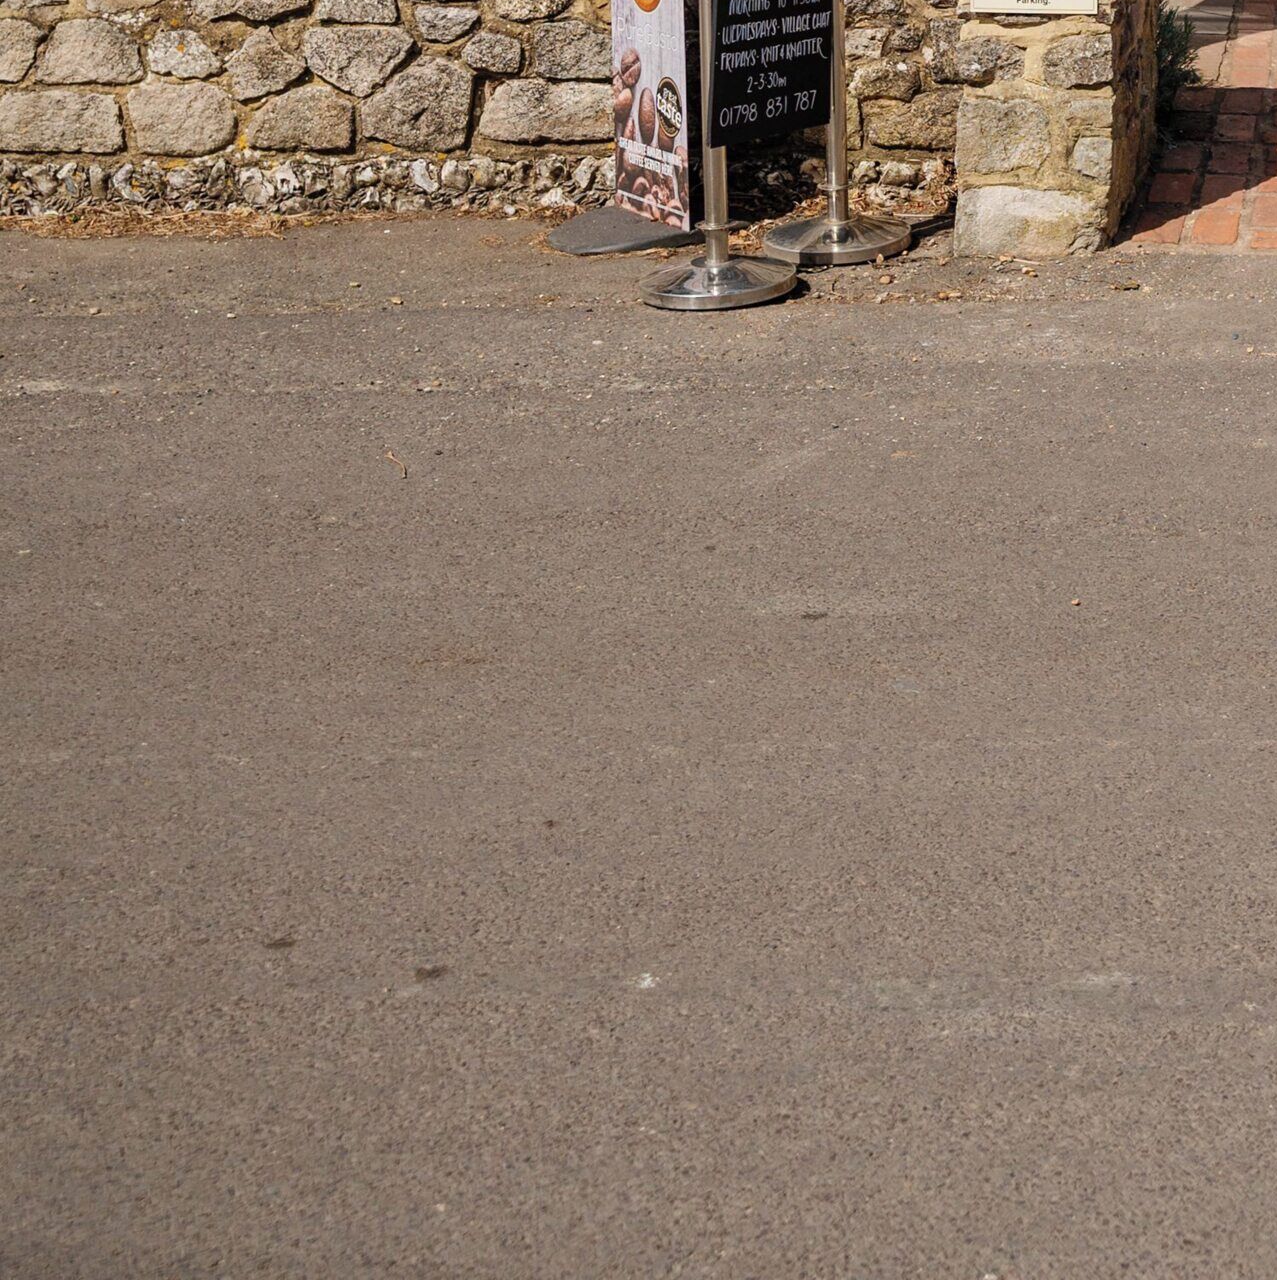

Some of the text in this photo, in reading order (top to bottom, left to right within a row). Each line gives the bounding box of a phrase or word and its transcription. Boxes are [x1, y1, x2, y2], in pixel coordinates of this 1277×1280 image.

[782, 13, 811, 34] VILLAGE
[812, 10, 832, 29] CHAT
[761, 44, 780, 68] KNIT
[785, 37, 829, 60] KNATTER
[657, 93, 682, 129] taste
[720, 90, 817, 127] 01798 831 787
